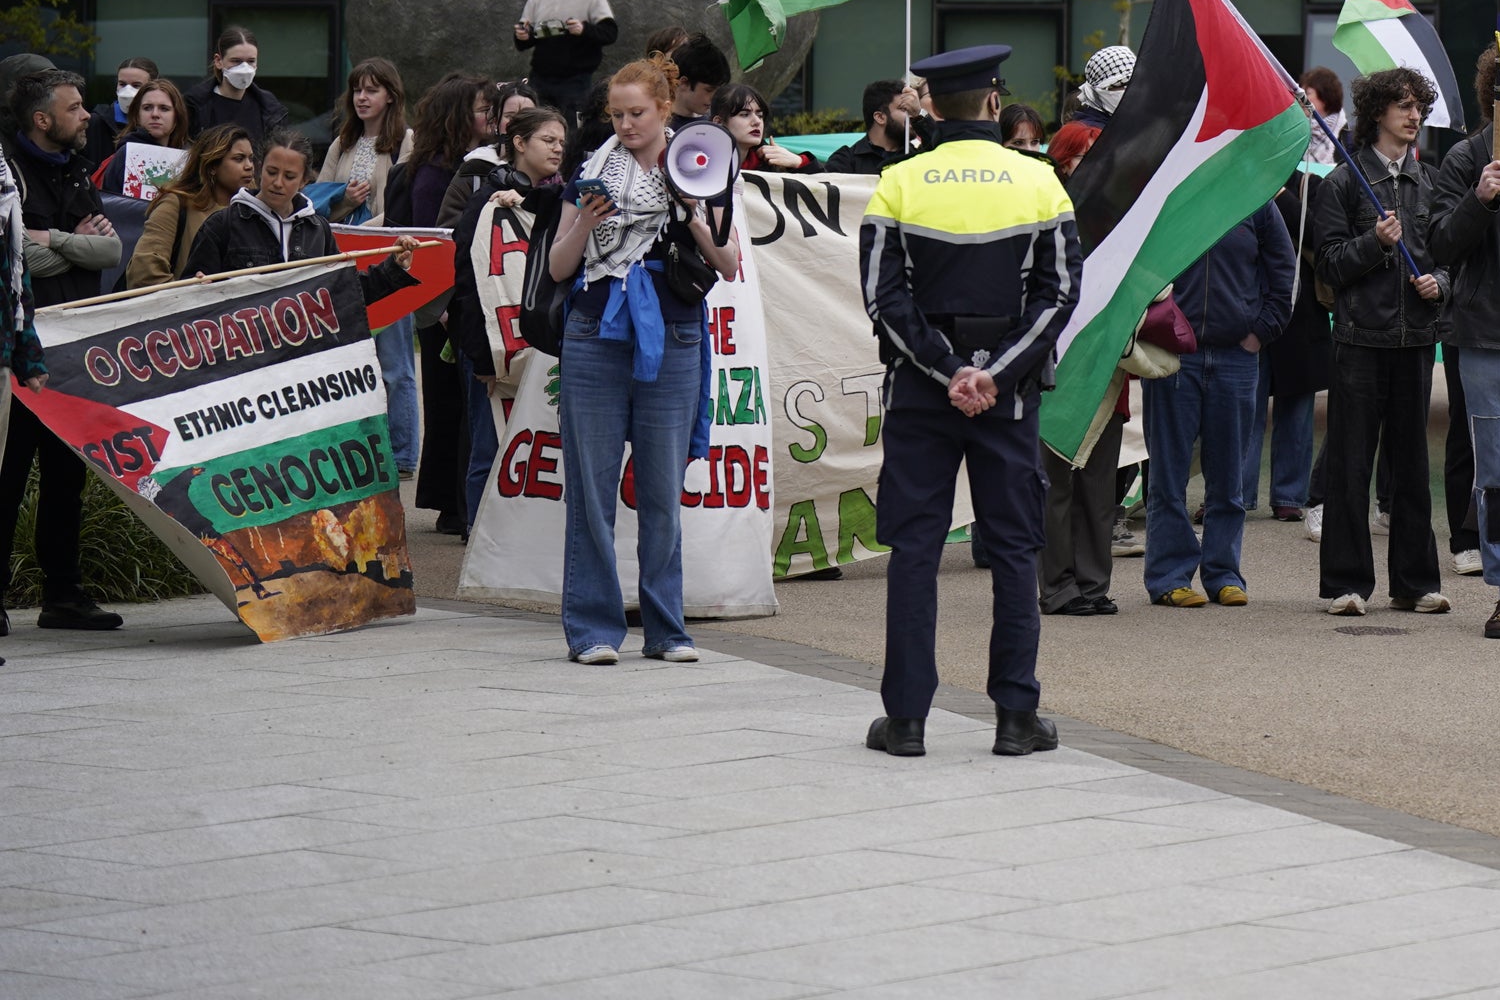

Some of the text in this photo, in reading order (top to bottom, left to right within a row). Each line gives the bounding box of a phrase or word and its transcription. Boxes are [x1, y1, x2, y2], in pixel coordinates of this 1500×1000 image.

[923, 169, 1014, 184] GARDA
[84, 287, 341, 387] OCCUPATION
[173, 364, 377, 442] ETHNIC CLEANSING
[211, 433, 390, 518] GENOCIDE
